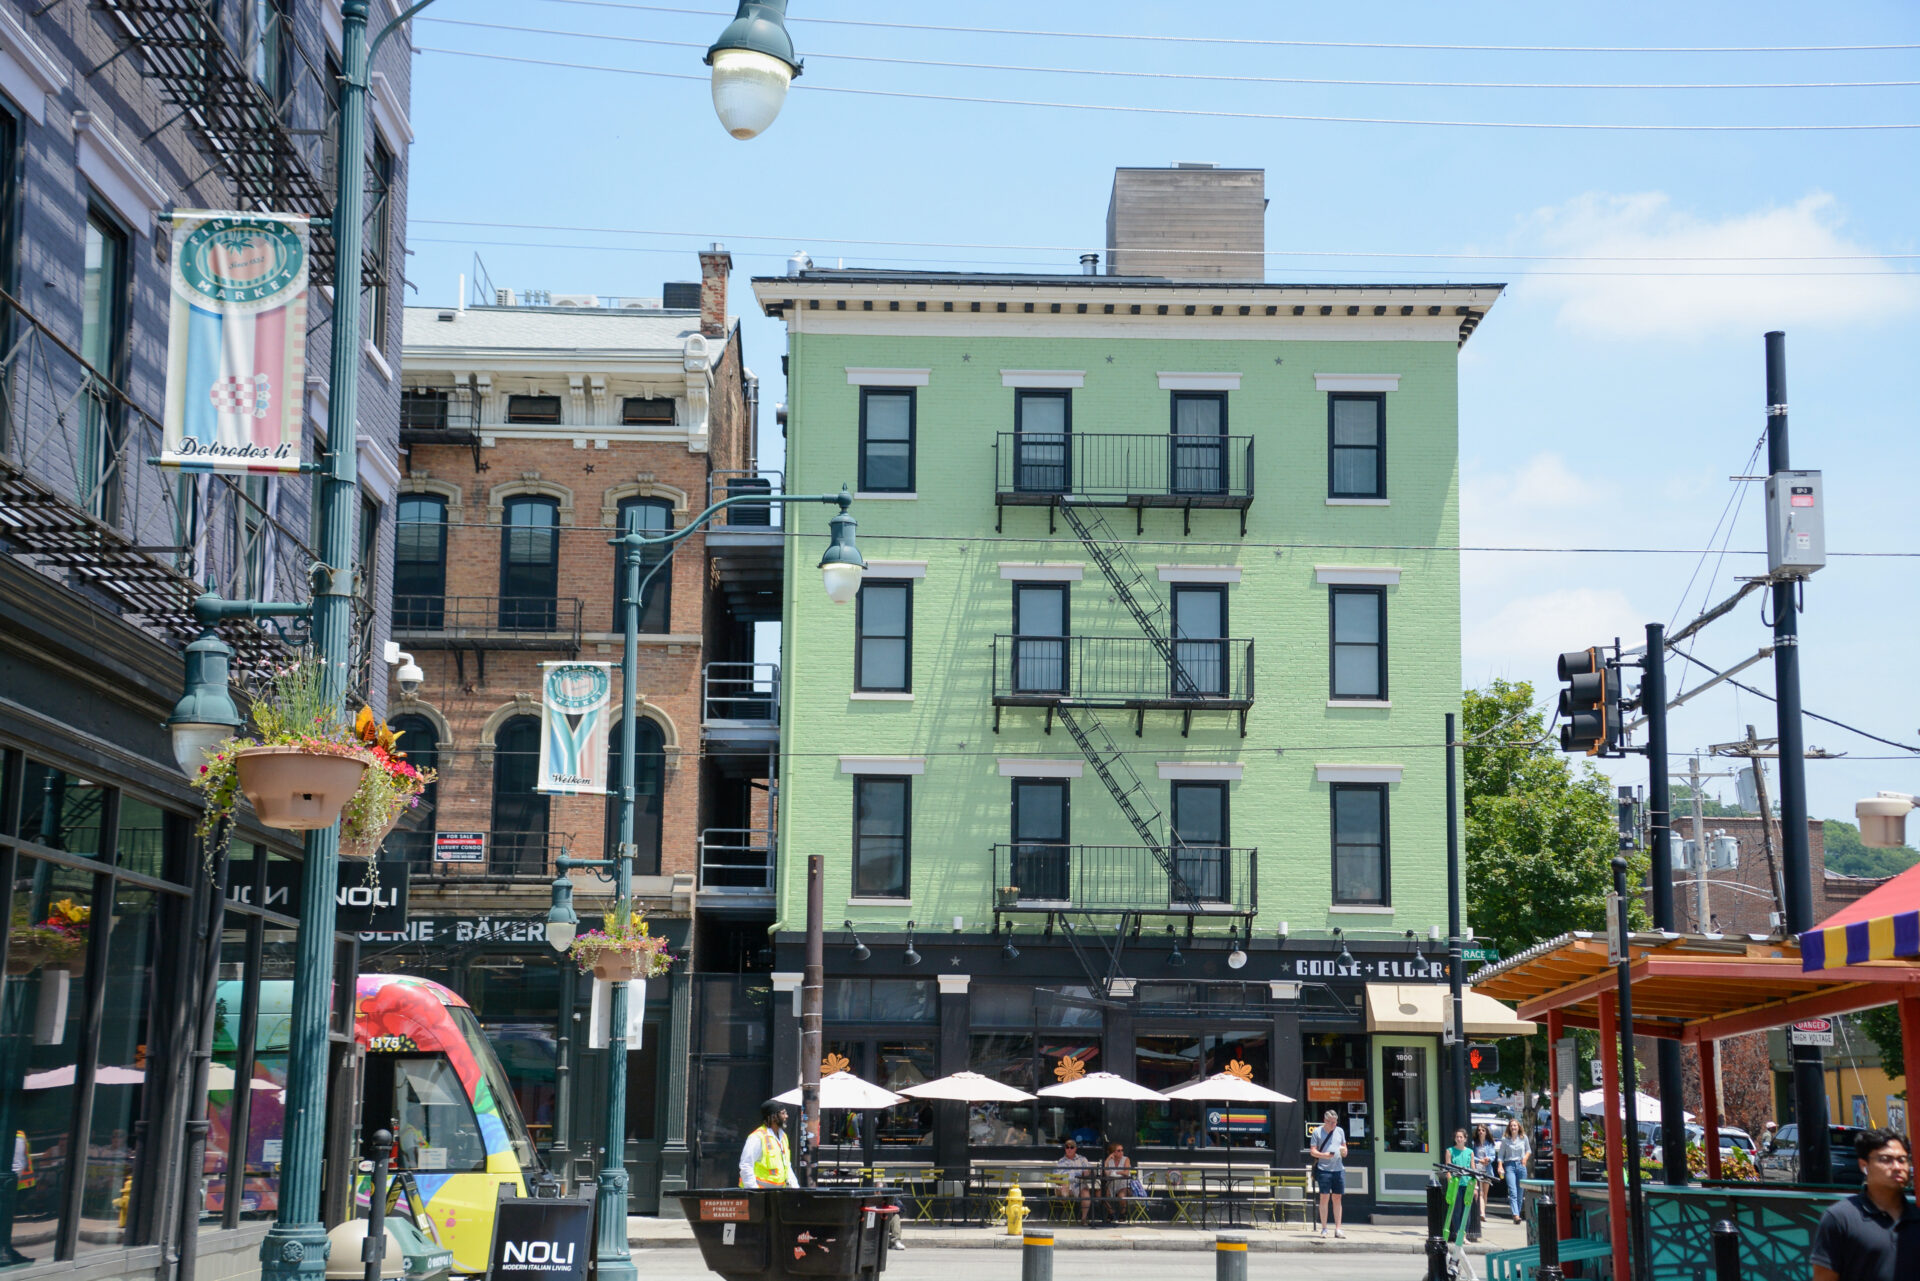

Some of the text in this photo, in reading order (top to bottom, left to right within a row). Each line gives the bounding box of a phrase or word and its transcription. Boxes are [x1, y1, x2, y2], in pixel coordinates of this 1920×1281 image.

[190, 217, 291, 245] FINDLAY
[198, 269, 291, 300] MARKET
[552, 664, 603, 679] FINDLAY
[556, 692, 602, 707] MARKET
[552, 774, 591, 785] Welkom
[336, 887, 398, 906] NOLI
[1463, 950, 1486, 959] RACE
[1296, 960, 1362, 977] GOOSE
[1378, 961, 1443, 978] ELDER
[1798, 1021, 1826, 1029] DANGER
[369, 1036, 399, 1048] 1175
[1808, 1034, 1832, 1043] VOLTAGE
[726, 1229, 732, 1238] 7
[503, 1241, 575, 1264] NOLI
[552, 1264, 572, 1272] LIVING
